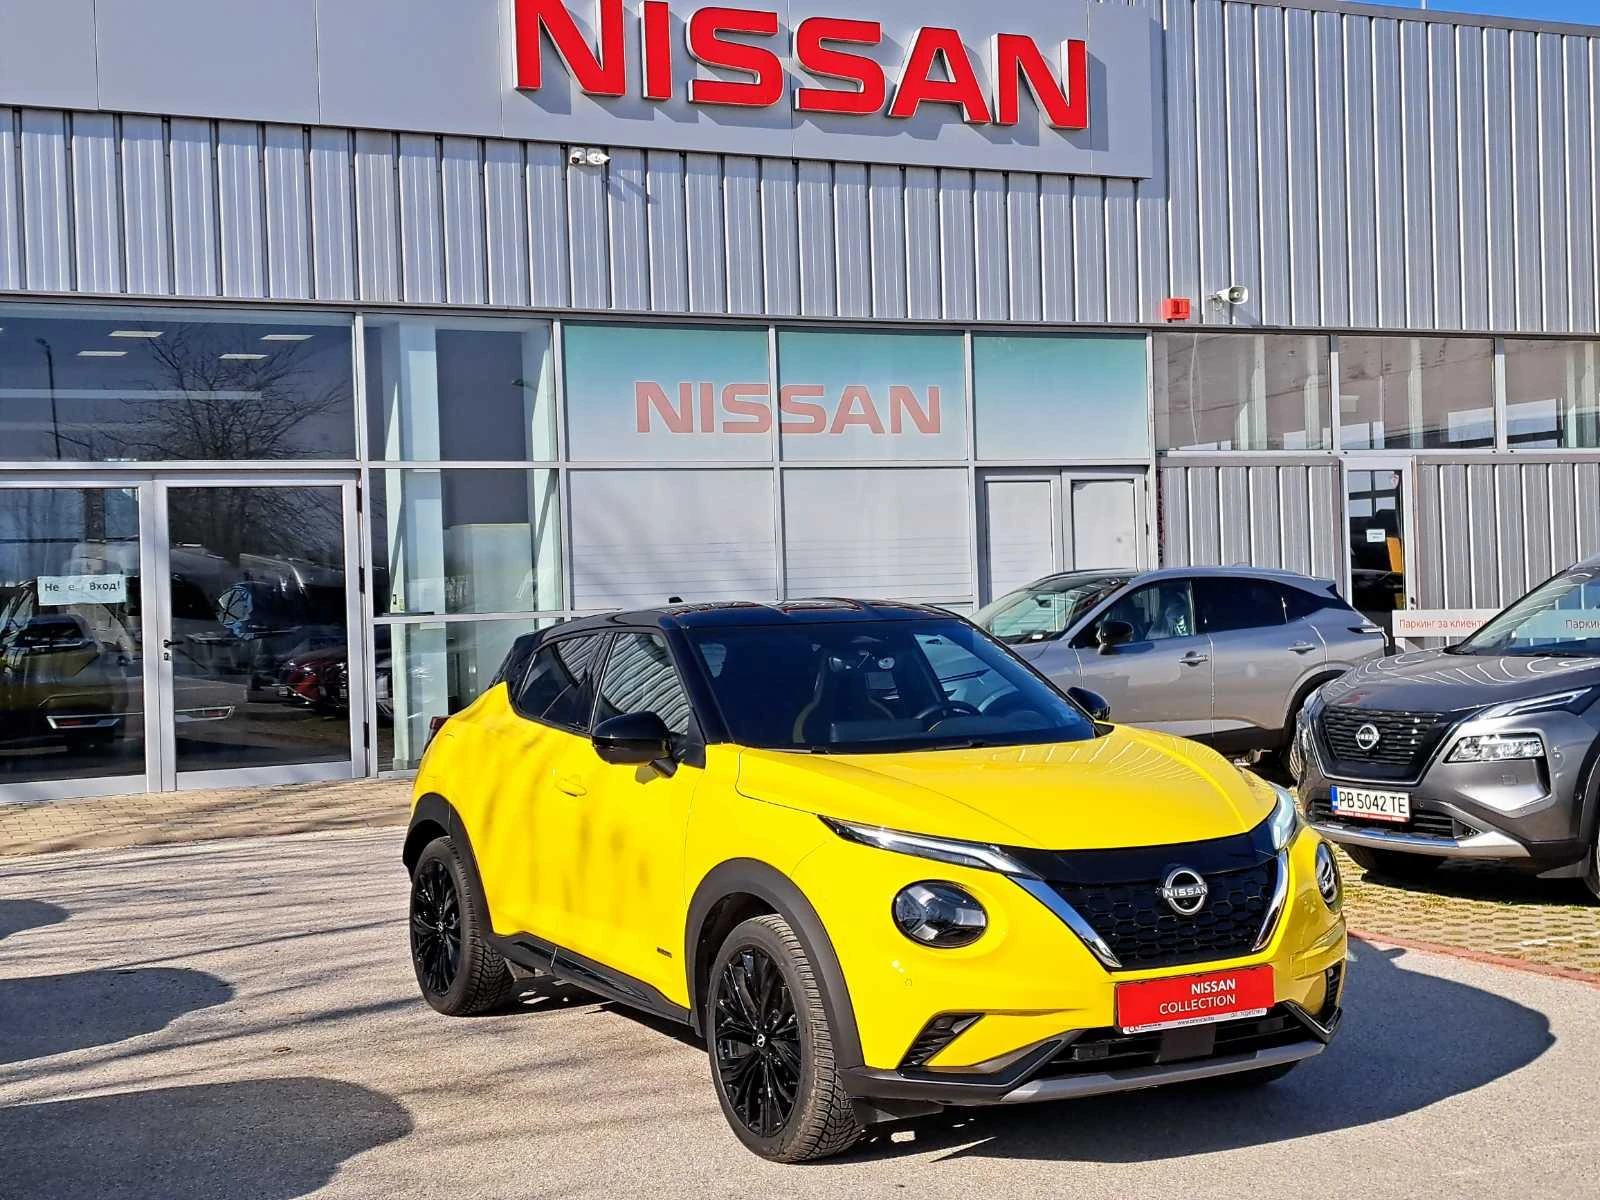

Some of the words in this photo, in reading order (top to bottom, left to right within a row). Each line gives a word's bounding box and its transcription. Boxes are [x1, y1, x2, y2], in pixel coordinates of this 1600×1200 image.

[511, 0, 1088, 130] NISSAN
[635, 381, 941, 434] NISSAN
[89, 580, 121, 592] Вход!
[1399, 619, 1435, 631] Паркинг
[1438, 620, 1448, 629] за
[1356, 793, 1387, 812] 5042
[1163, 884, 1208, 898] NISSAN
[1191, 978, 1236, 995] NISSAN
[1159, 994, 1236, 1015] COLLECTION
